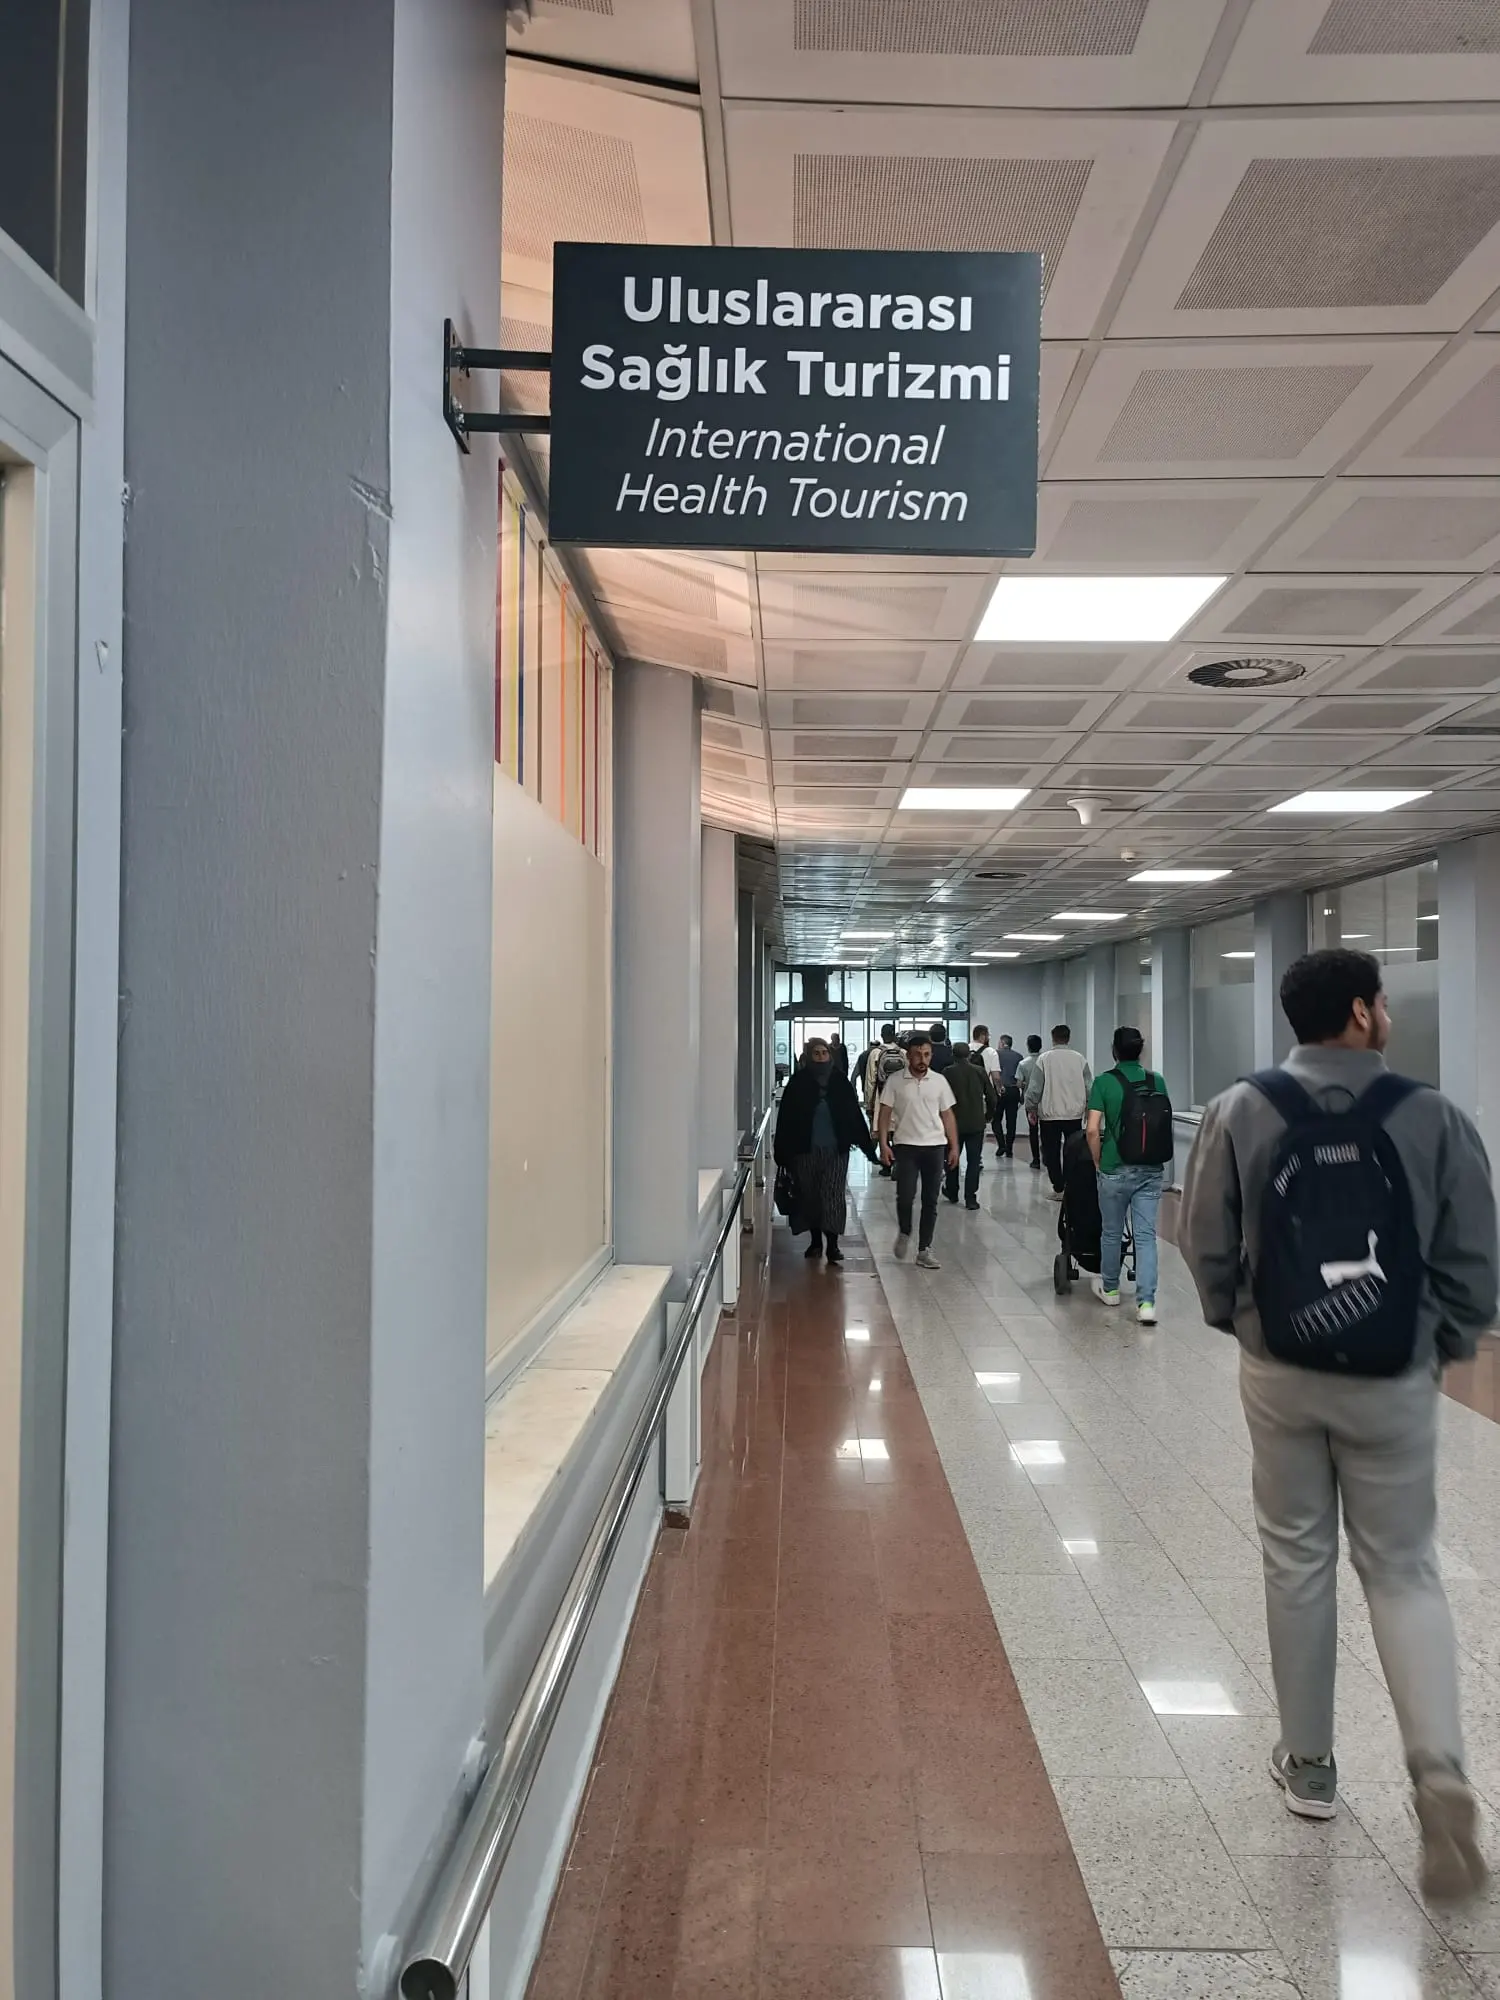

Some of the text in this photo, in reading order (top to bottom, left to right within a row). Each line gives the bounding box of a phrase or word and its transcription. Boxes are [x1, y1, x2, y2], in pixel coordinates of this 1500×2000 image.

[624, 276, 973, 332] Uluslararası
[580, 344, 1011, 401] Sağlık Turizmi
[644, 418, 947, 465] International
[615, 472, 969, 522] Health Tourism
